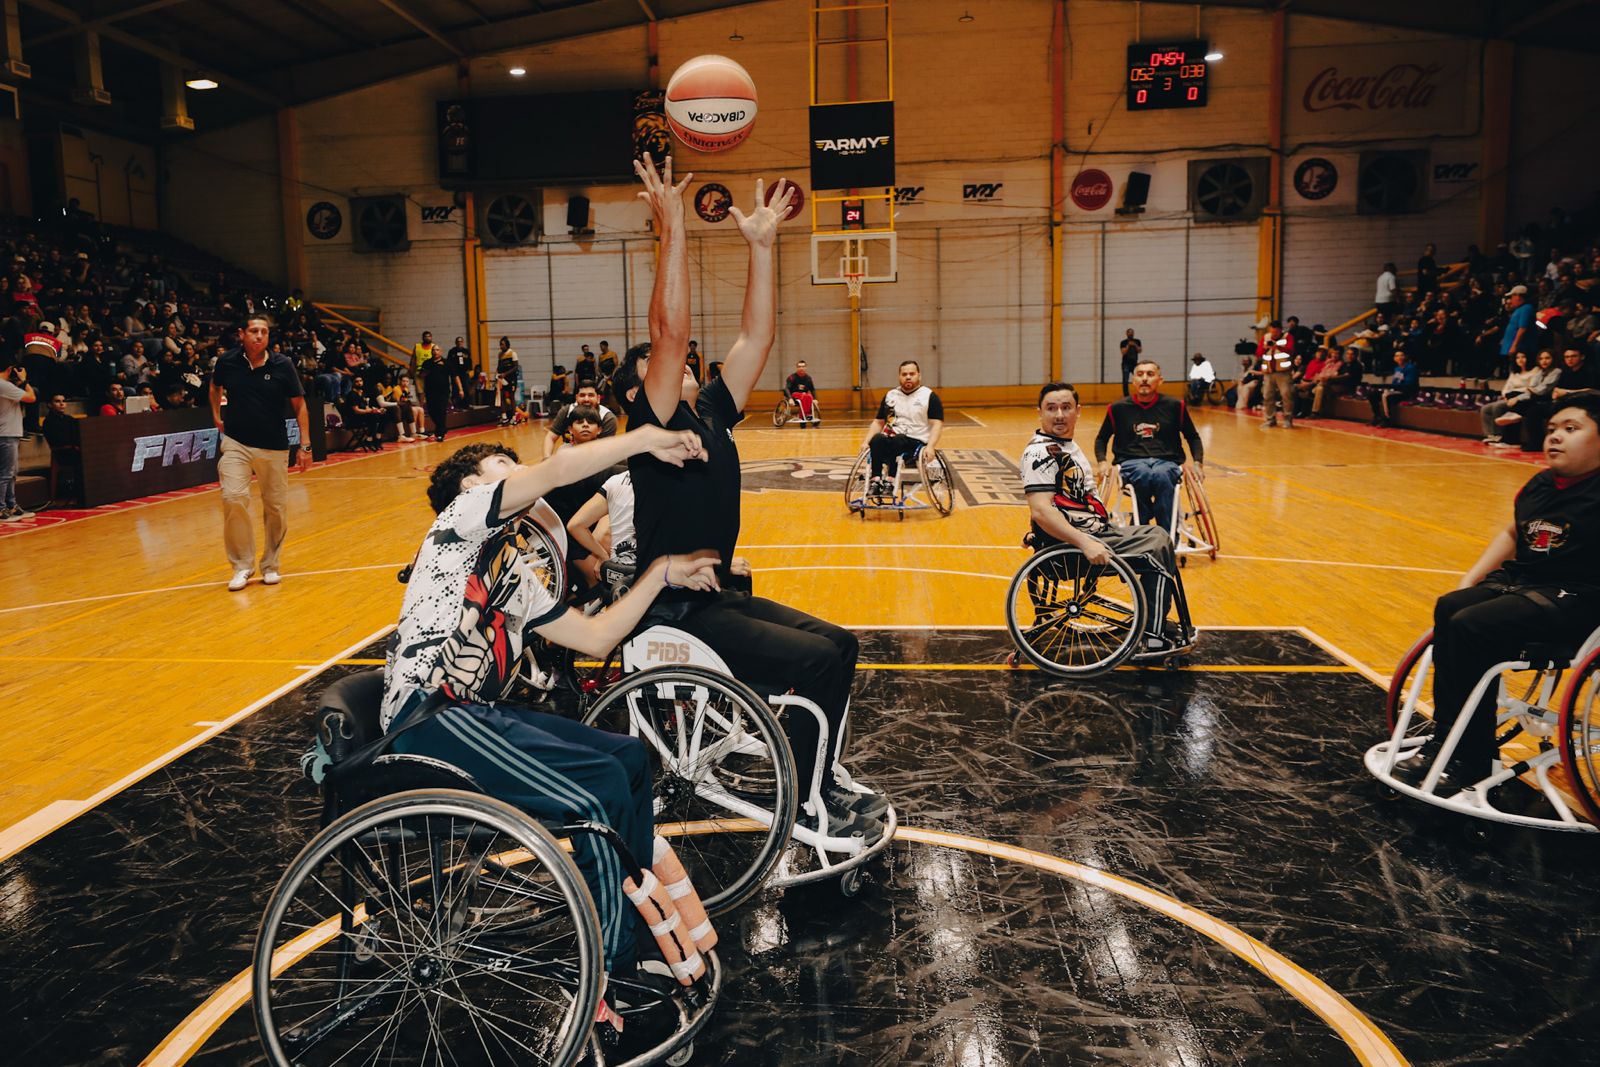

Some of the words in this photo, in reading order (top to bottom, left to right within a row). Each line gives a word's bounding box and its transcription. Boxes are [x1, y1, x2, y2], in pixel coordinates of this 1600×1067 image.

[1130, 67, 1156, 82] 052
[1136, 89, 1148, 104] 0
[1187, 86, 1199, 101] 0
[1303, 63, 1445, 113] Coca-Cola
[821, 137, 883, 152] ARMY
[846, 210, 860, 221] 24
